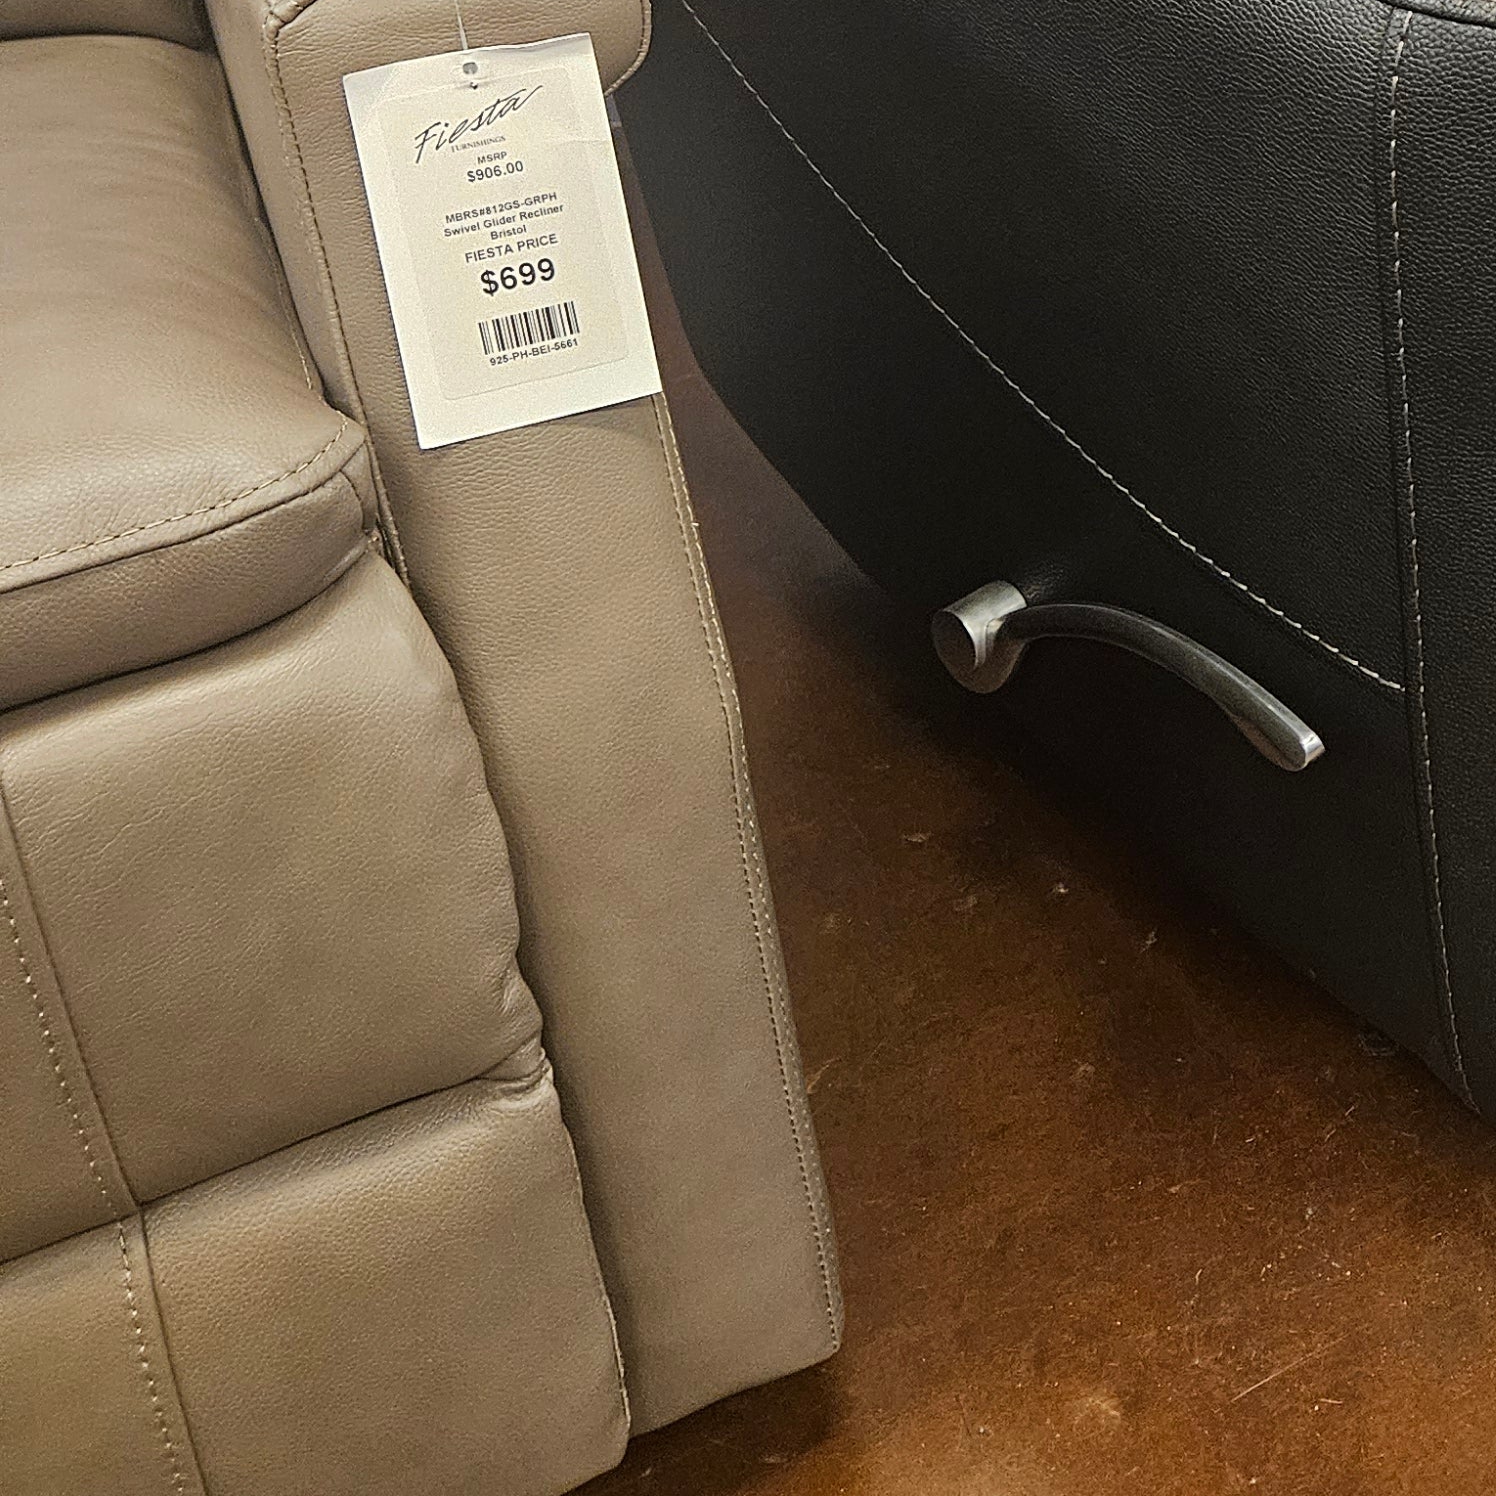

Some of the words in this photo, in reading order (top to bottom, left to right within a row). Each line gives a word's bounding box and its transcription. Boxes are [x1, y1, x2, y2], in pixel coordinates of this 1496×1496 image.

[414, 84, 543, 164] Fiesta
[450, 135, 507, 153] FURNISHINGS
[476, 151, 508, 165] MSRP
[466, 160, 524, 183] $906.00
[443, 221, 481, 237] Swivel
[482, 214, 516, 229] Glider
[519, 204, 564, 221] Recliner
[445, 192, 557, 224] MBRS#812GS-GRPH
[490, 225, 527, 240] Bristol
[464, 244, 513, 263] FIESTA
[516, 234, 558, 253] PRICE
[480, 258, 556, 297] $699
[489, 338, 578, 366] 925-PH-BEI-5661
